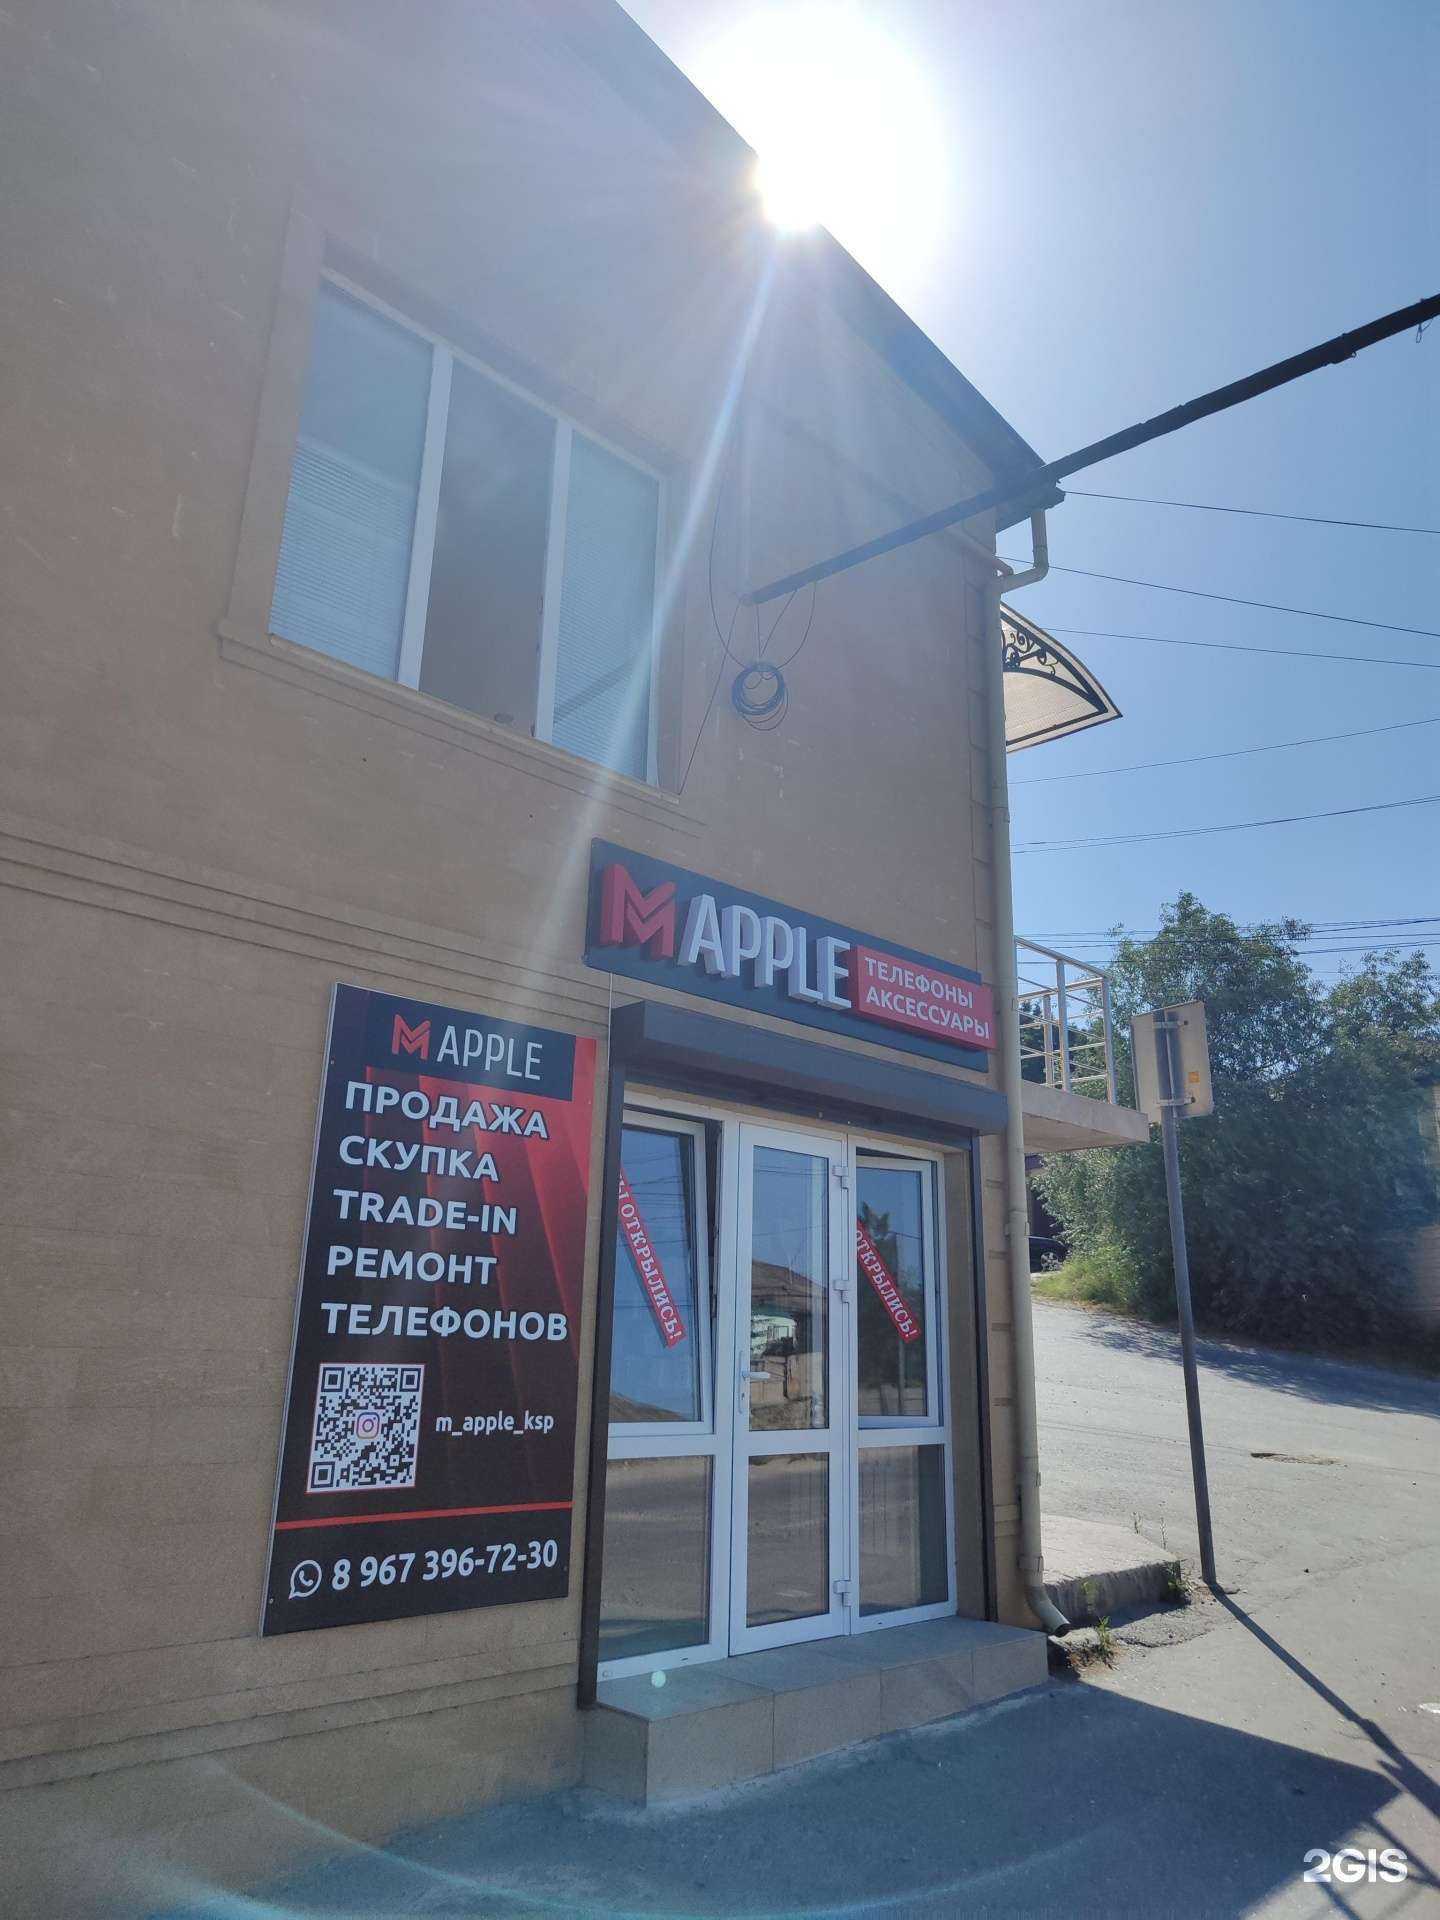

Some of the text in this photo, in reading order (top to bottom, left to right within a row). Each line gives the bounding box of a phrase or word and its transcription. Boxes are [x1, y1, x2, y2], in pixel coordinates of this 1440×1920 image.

[678, 894, 851, 1009] APPLE
[865, 956, 973, 1008] ТЕЛЕФОНЫ
[866, 989, 990, 1039] АКСЕССУАРЫ
[437, 1026, 543, 1080] APPLE
[345, 1081, 548, 1138] ПРОДАЖА
[339, 1136, 499, 1181] СКУПКА
[332, 1188, 517, 1235] TRADE-IN
[326, 1245, 497, 1286] РЕМОНТ
[621, 1203, 682, 1340] ОТКРЫЛИСЬ!
[320, 1302, 568, 1342] ТЕЛЕФОНОВ
[435, 1410, 554, 1436] m_apple_ksp
[331, 1539, 559, 1592] 8 967 396-72-30
